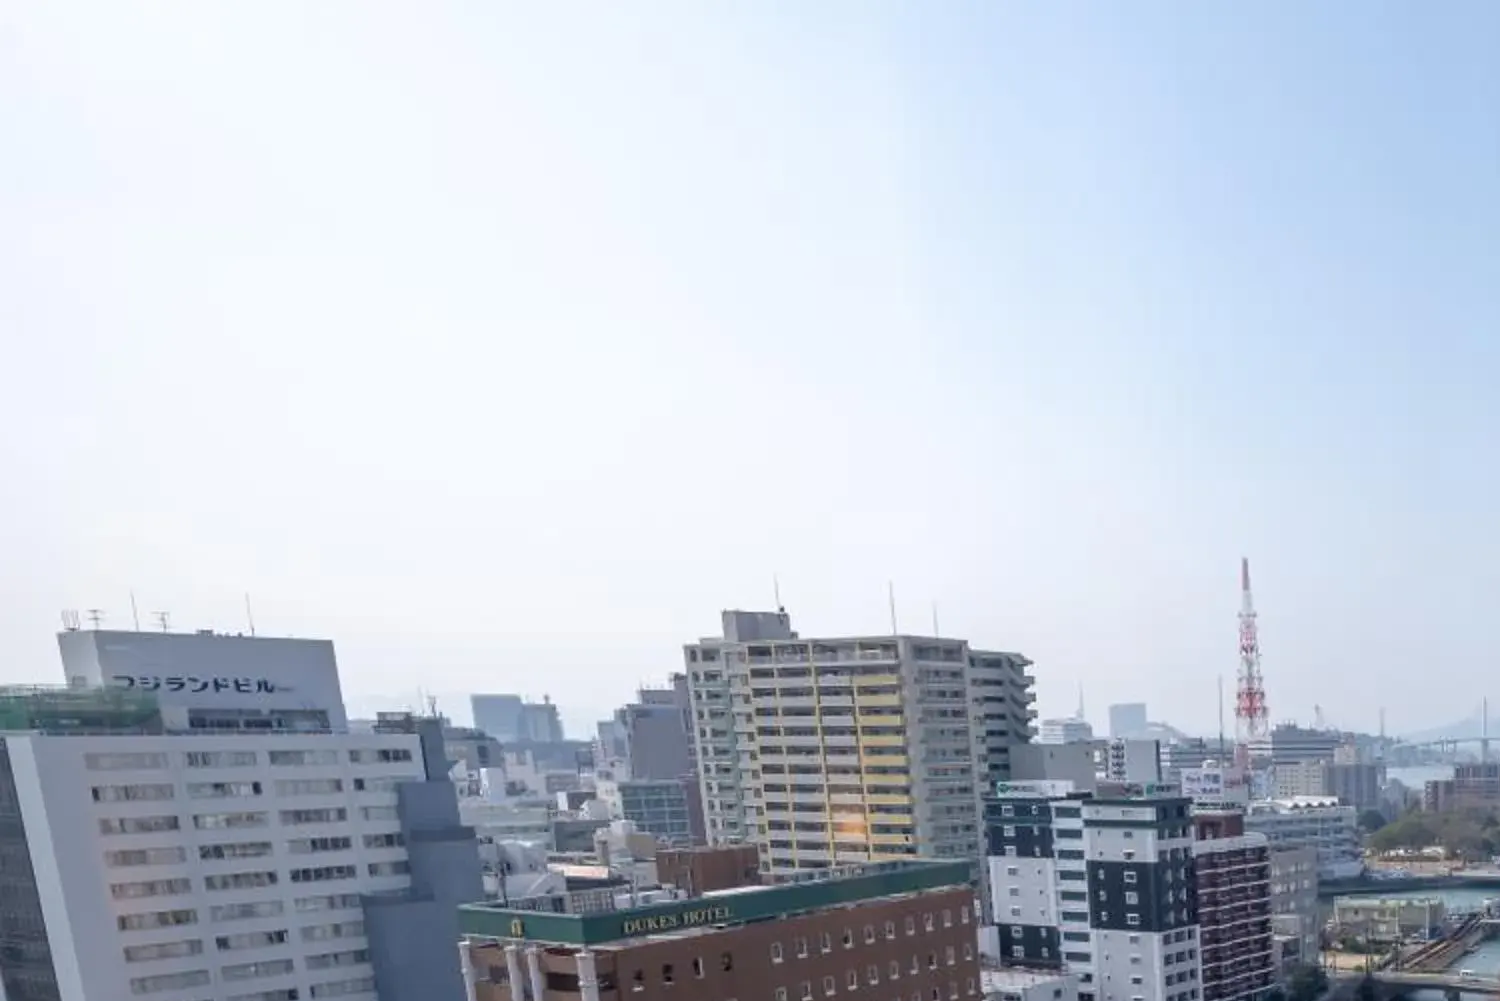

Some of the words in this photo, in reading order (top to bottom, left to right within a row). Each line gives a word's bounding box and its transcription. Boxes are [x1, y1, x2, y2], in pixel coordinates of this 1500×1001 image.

[112, 675, 275, 694] フジランドビル
[623, 915, 677, 934] DUKES
[683, 907, 731, 925] HOTEL
